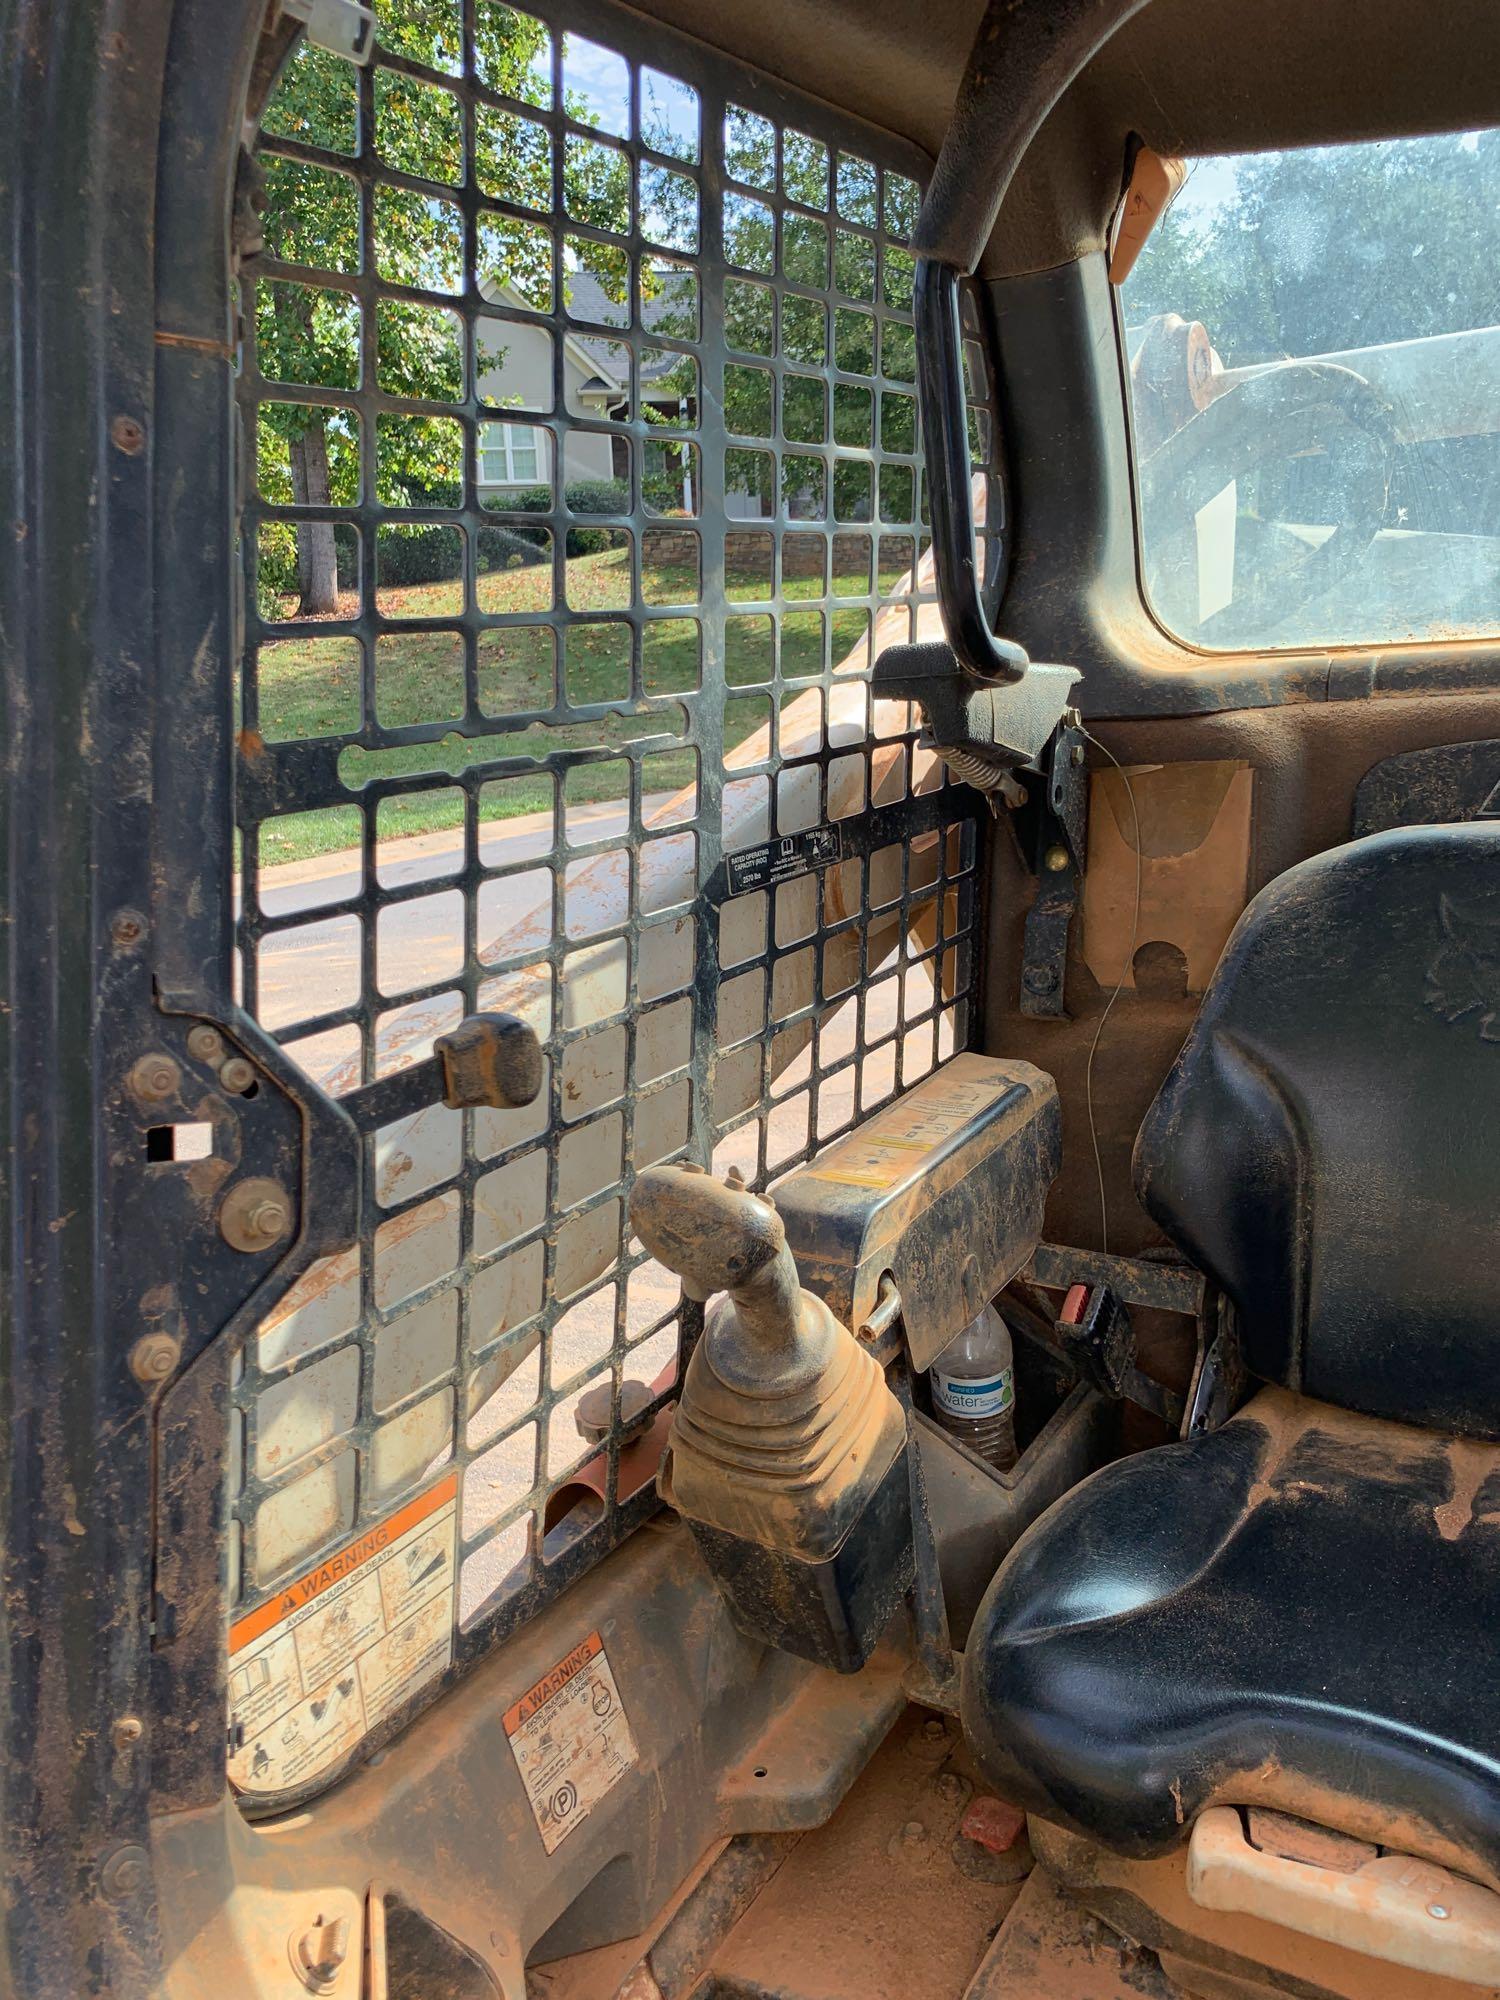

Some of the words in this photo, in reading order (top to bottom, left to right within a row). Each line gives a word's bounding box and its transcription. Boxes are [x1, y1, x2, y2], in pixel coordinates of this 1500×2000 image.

[731, 855, 746, 865] RATED
[746, 848, 770, 861] OPERATING
[734, 859, 755, 871] CAPACITY
[755, 856, 768, 867] (ROC)
[743, 874, 753, 883] 2570
[753, 872, 762, 881] lbs
[301, 1528, 388, 1598] WARNING
[286, 1604, 314, 1629] AVOID
[315, 1580, 349, 1607] INJURY
[350, 1570, 364, 1583] OR
[365, 1547, 394, 1571] DEATH
[529, 1644, 592, 1707] WARNING
[526, 1711, 544, 1731] AVOID
[544, 1692, 565, 1714] INJURY
[565, 1682, 575, 1693] OR
[575, 1665, 593, 1684] DEATH
[594, 1693, 610, 1711] STOP
[530, 1727, 539, 1737] TO
[540, 1710, 559, 1729] LEAVE
[558, 1699, 571, 1713] THE
